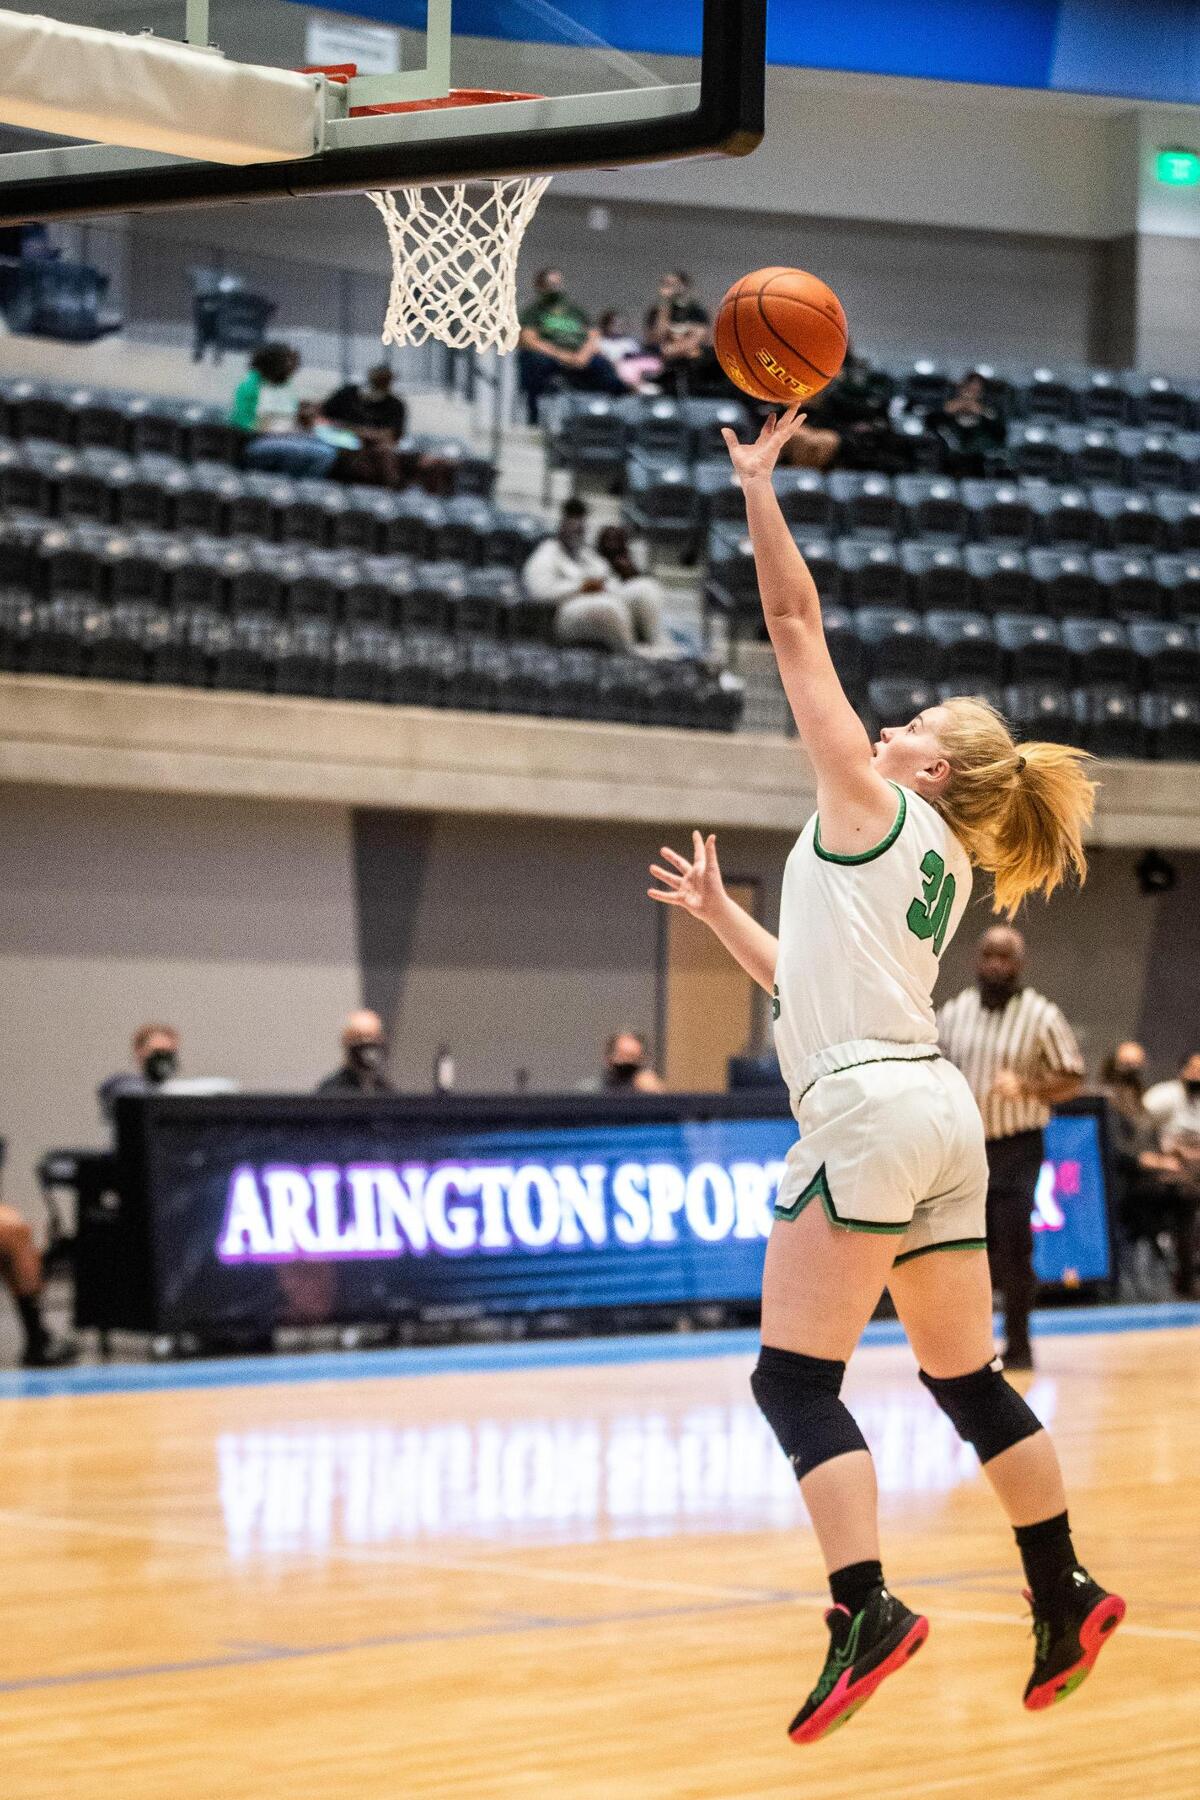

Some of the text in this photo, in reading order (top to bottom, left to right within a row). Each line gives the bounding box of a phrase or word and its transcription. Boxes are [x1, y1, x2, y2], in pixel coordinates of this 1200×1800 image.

[755, 348, 813, 396] ELITE
[906, 849, 956, 957] 30
[220, 1163, 606, 1256] ARLINGTON
